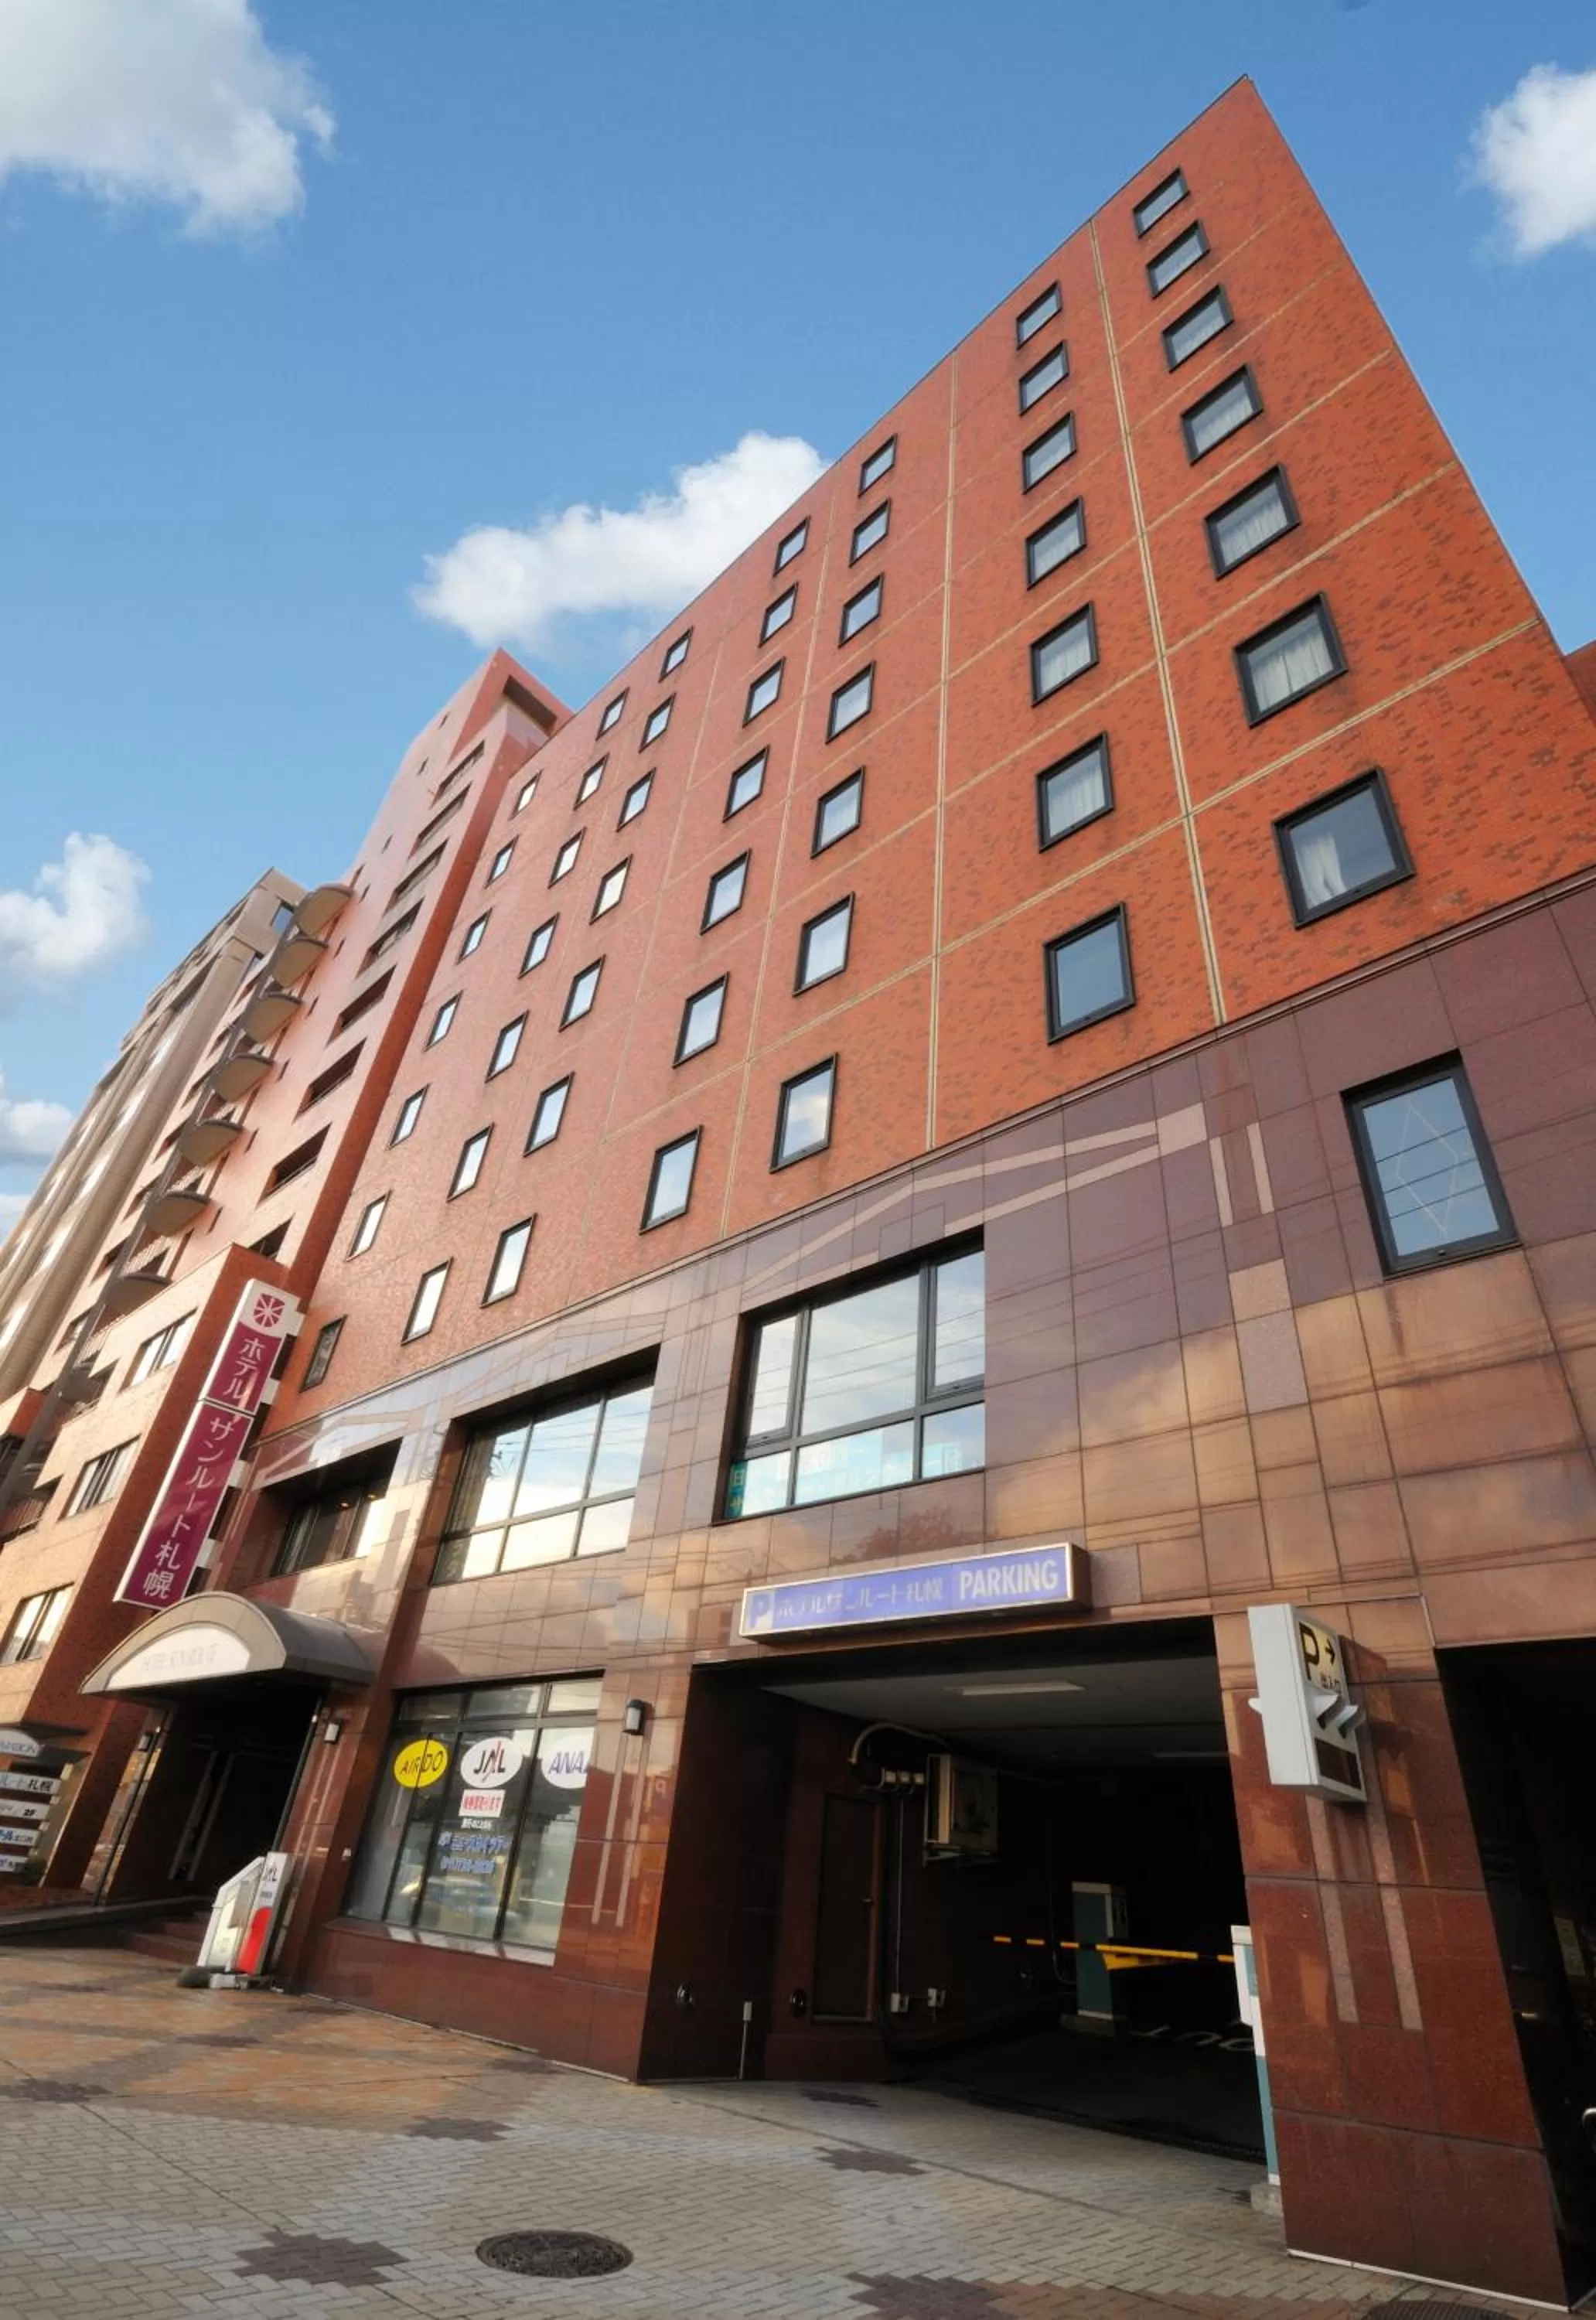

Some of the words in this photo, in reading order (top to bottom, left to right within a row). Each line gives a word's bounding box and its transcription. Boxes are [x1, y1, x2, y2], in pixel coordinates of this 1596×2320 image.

[960, 1559, 1059, 1601] PARKING
[1299, 1622, 1319, 1681] P
[473, 1747, 506, 1778] JAL
[548, 1750, 585, 1774] ANA
